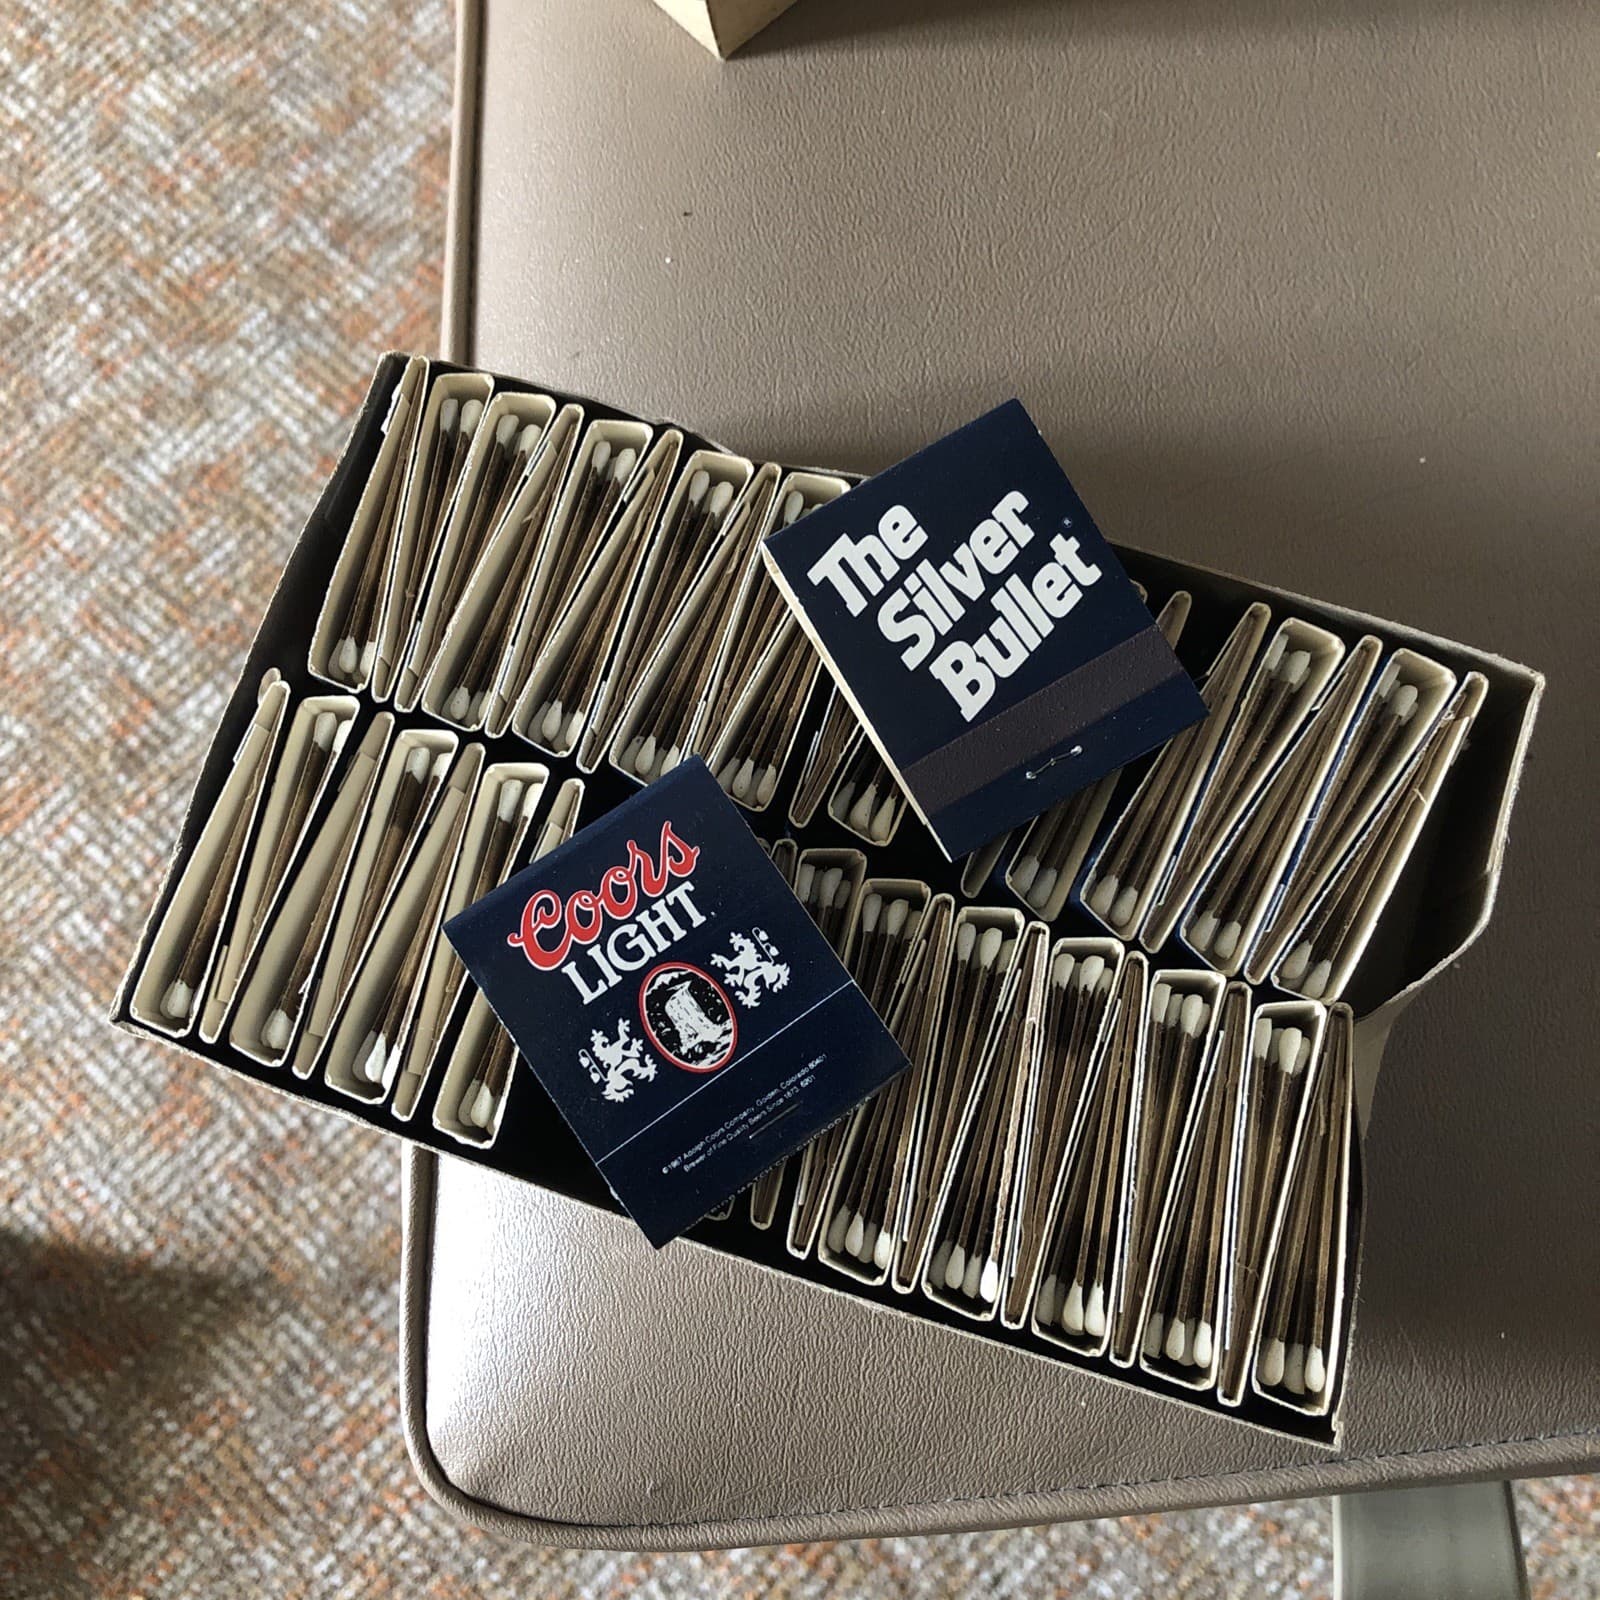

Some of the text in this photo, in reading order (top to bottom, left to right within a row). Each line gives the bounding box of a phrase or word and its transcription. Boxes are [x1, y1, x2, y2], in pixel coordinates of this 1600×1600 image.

[806, 504, 929, 618] The
[877, 490, 1035, 672] Silver
[928, 532, 1102, 723] Bullet
[507, 820, 700, 971] Coors
[561, 880, 707, 1005] LIGHT
[704, 1127, 726, 1143] Coors
[779, 1066, 810, 1090] Colorado
[726, 1123, 750, 1141] Quality
[766, 1097, 785, 1113] Since
